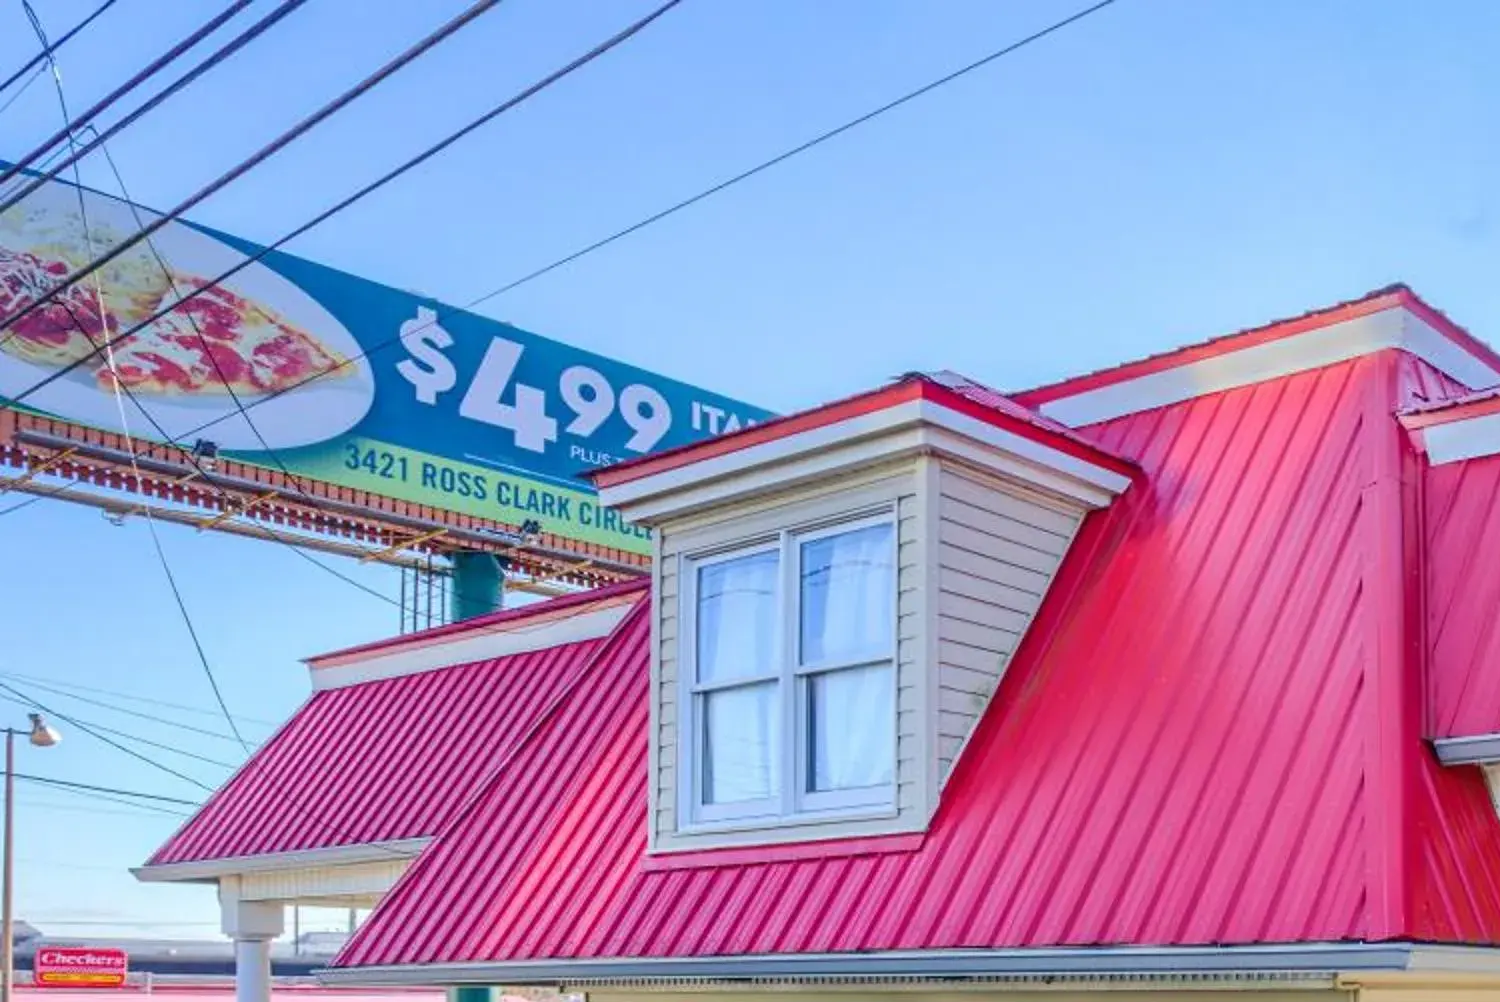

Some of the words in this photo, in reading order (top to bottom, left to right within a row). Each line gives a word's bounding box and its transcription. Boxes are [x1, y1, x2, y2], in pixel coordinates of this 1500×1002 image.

[345, 443, 408, 483] 3421
[422, 458, 487, 501] ROSS
[497, 482, 572, 522] CLARK
[41, 952, 125, 967] Checkers
